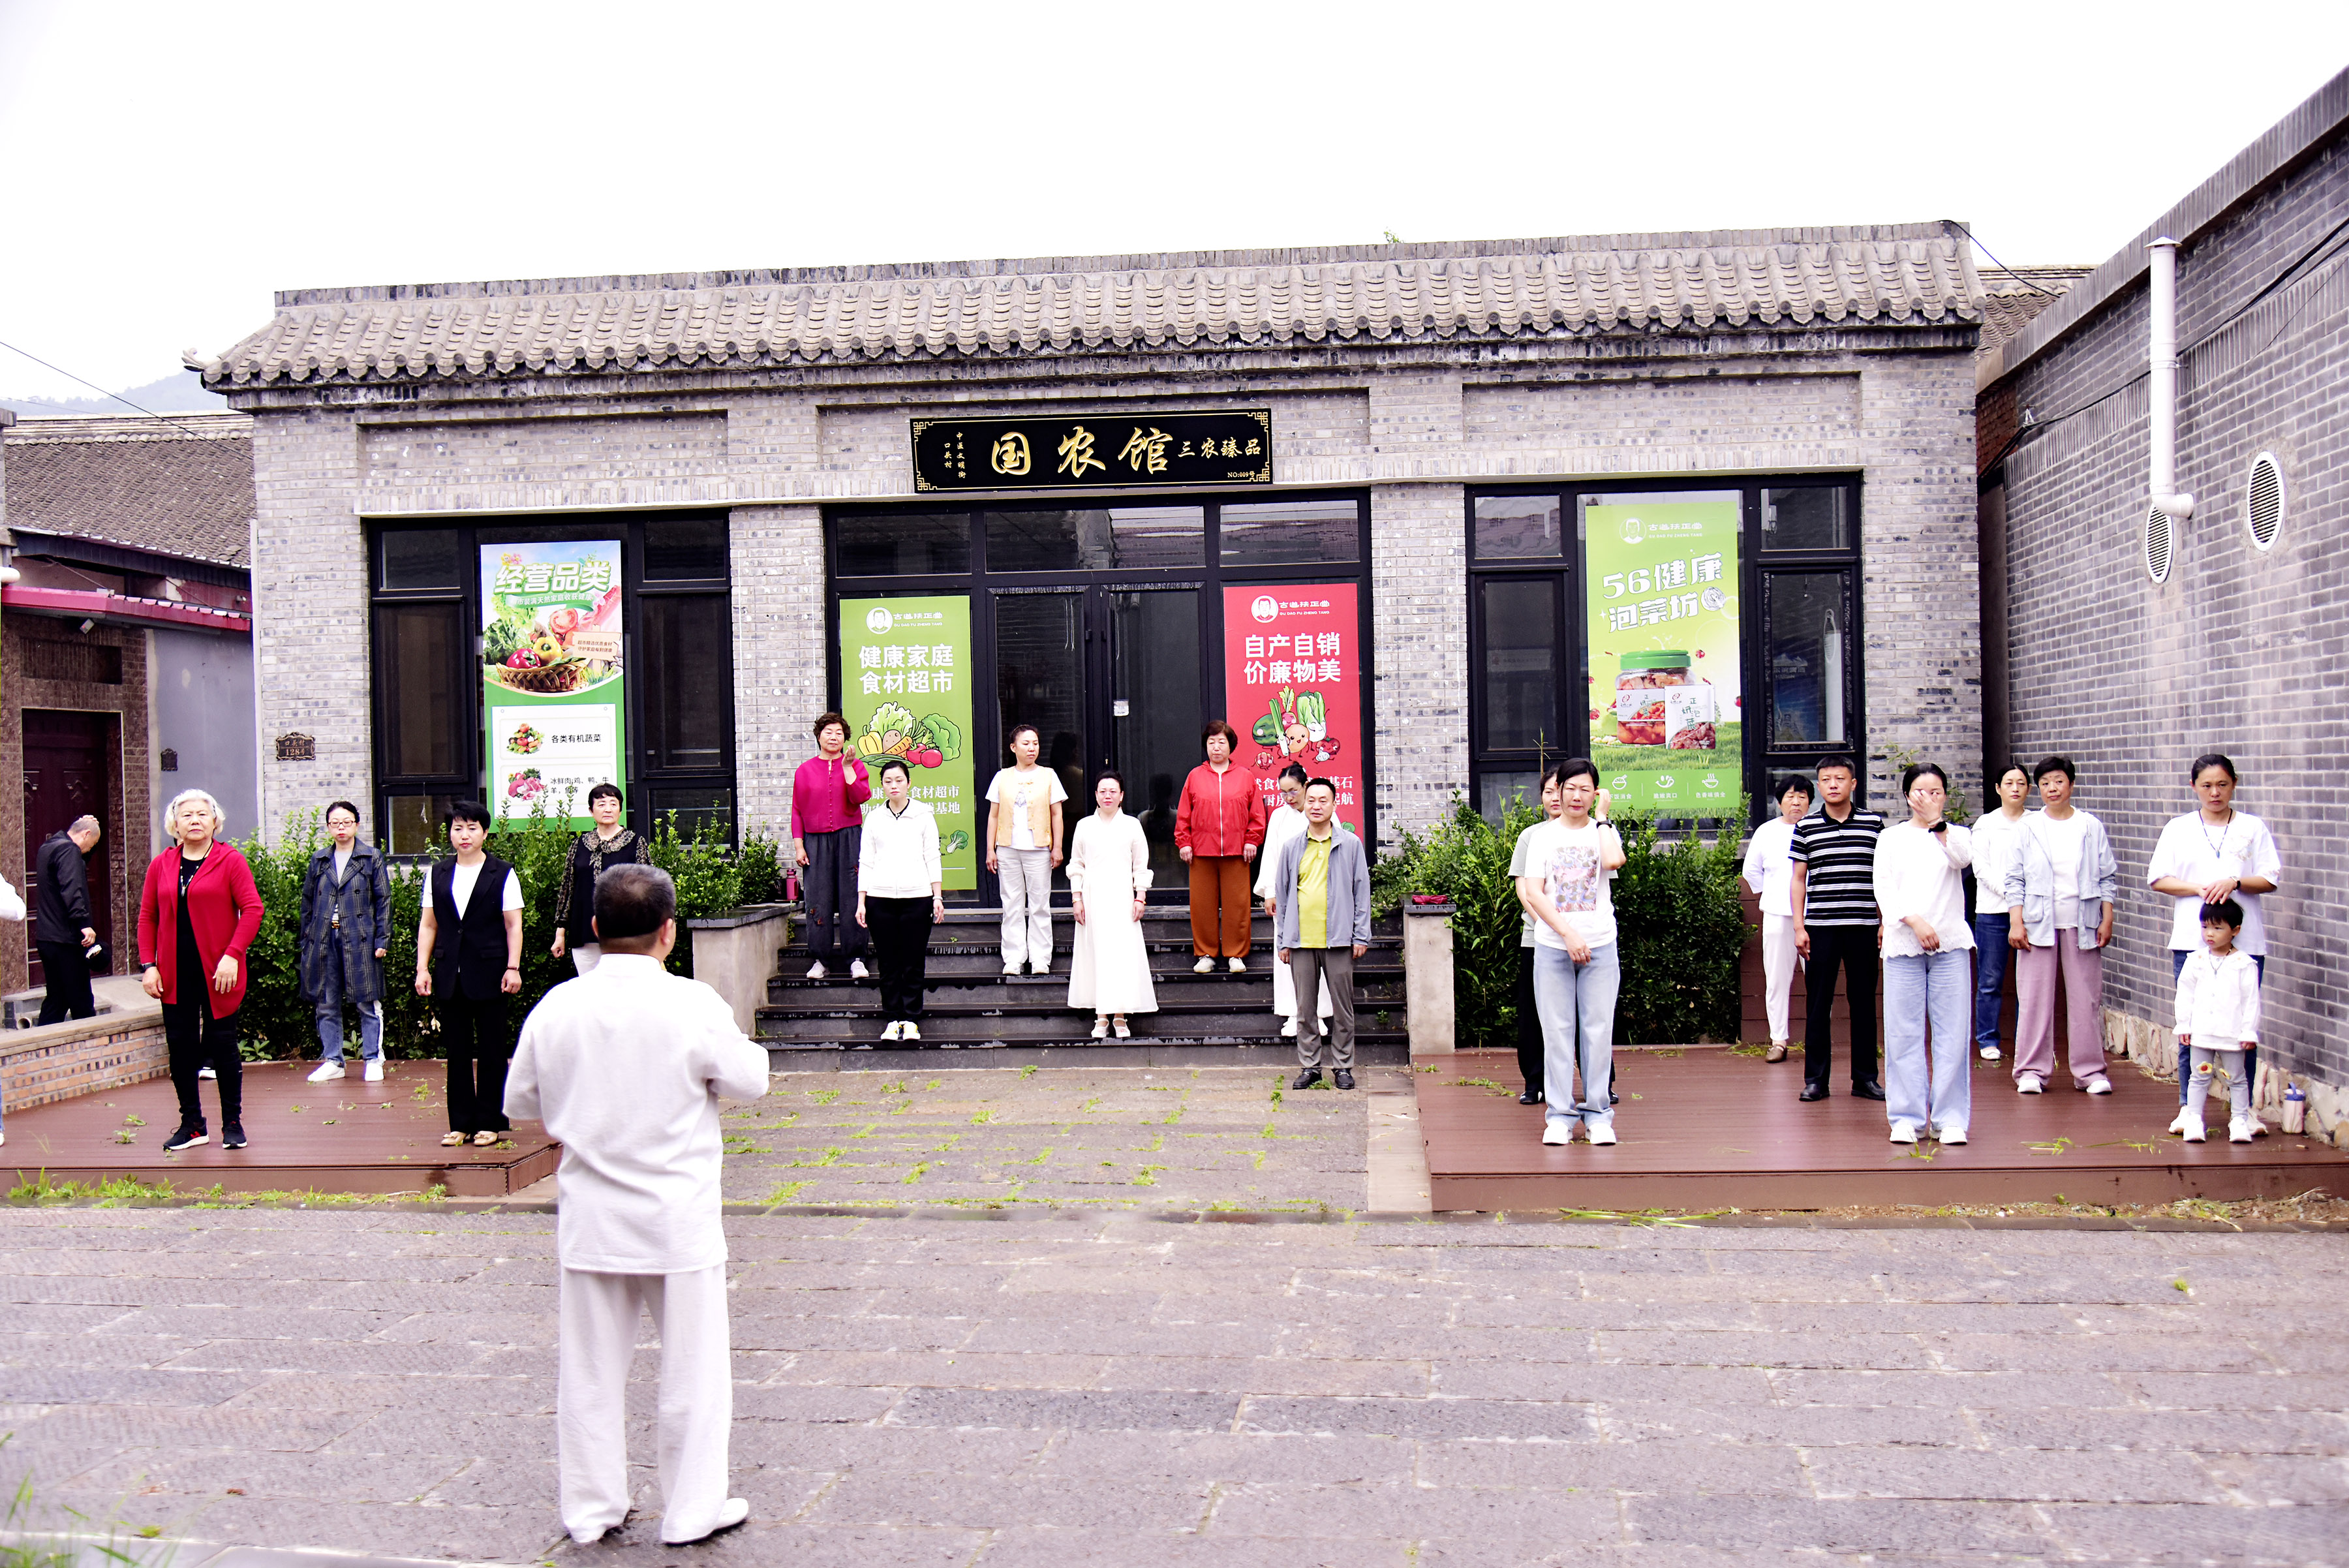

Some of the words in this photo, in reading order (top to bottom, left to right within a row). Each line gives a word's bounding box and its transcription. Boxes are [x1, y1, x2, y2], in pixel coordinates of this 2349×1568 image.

[992, 425, 1173, 478] 国农馆
[1178, 437, 1261, 459] 三农臻品
[493, 561, 611, 594] 经营品类
[1603, 551, 1723, 599] 56健康
[511, 593, 593, 606] 市装满天然家庭收获健康
[1608, 591, 1699, 633] 泡菜坊
[859, 643, 954, 668] 健康家庭
[1245, 632, 1340, 658] 自产自销
[859, 669, 954, 695] 食材超市
[1244, 658, 1341, 684] 价廉物美
[551, 733, 602, 743] 各类有机蔬菜
